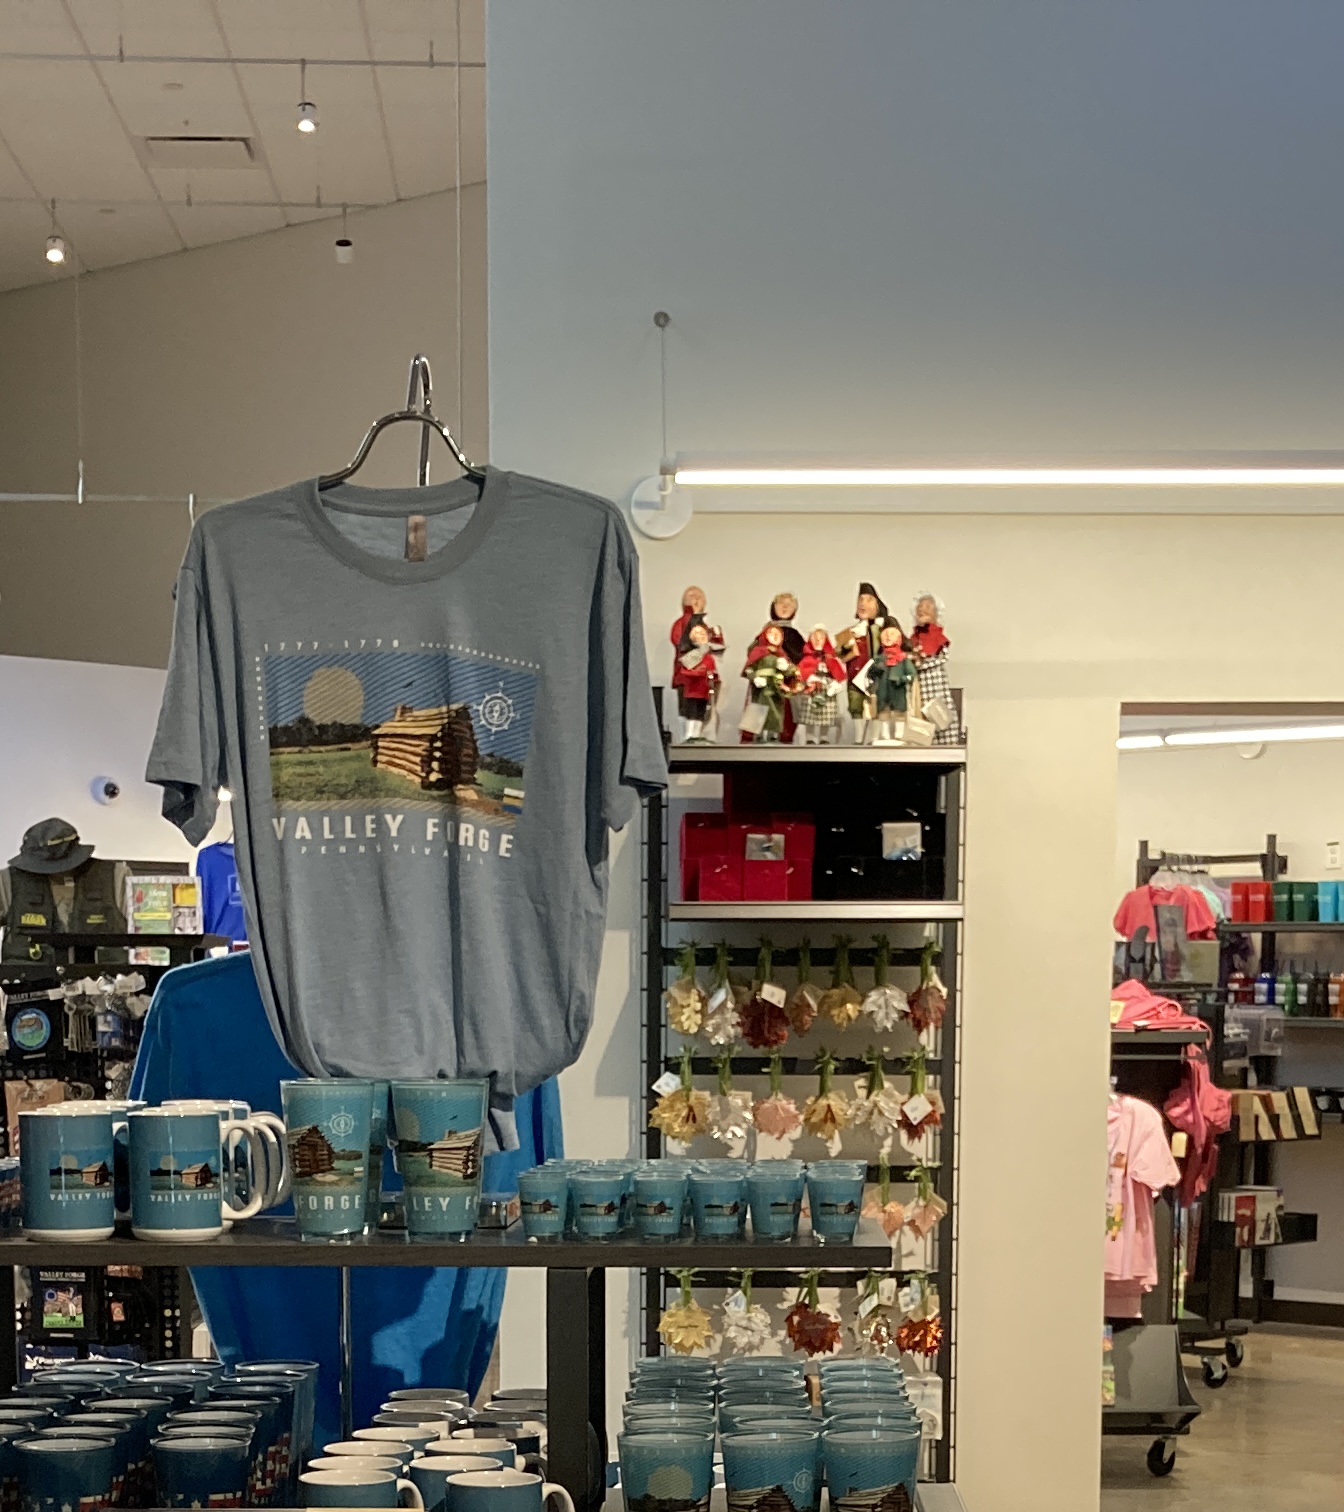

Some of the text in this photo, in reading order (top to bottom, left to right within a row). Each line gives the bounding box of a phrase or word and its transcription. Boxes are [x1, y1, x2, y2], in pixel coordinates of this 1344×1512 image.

[272, 813, 515, 859] VALLEY FORGE
[301, 843, 485, 866] PENNSYLVAIA
[50, 1192, 91, 1201] VALLEY
[150, 1193, 191, 1202] VALLEY
[412, 1196, 450, 1212] LEY
